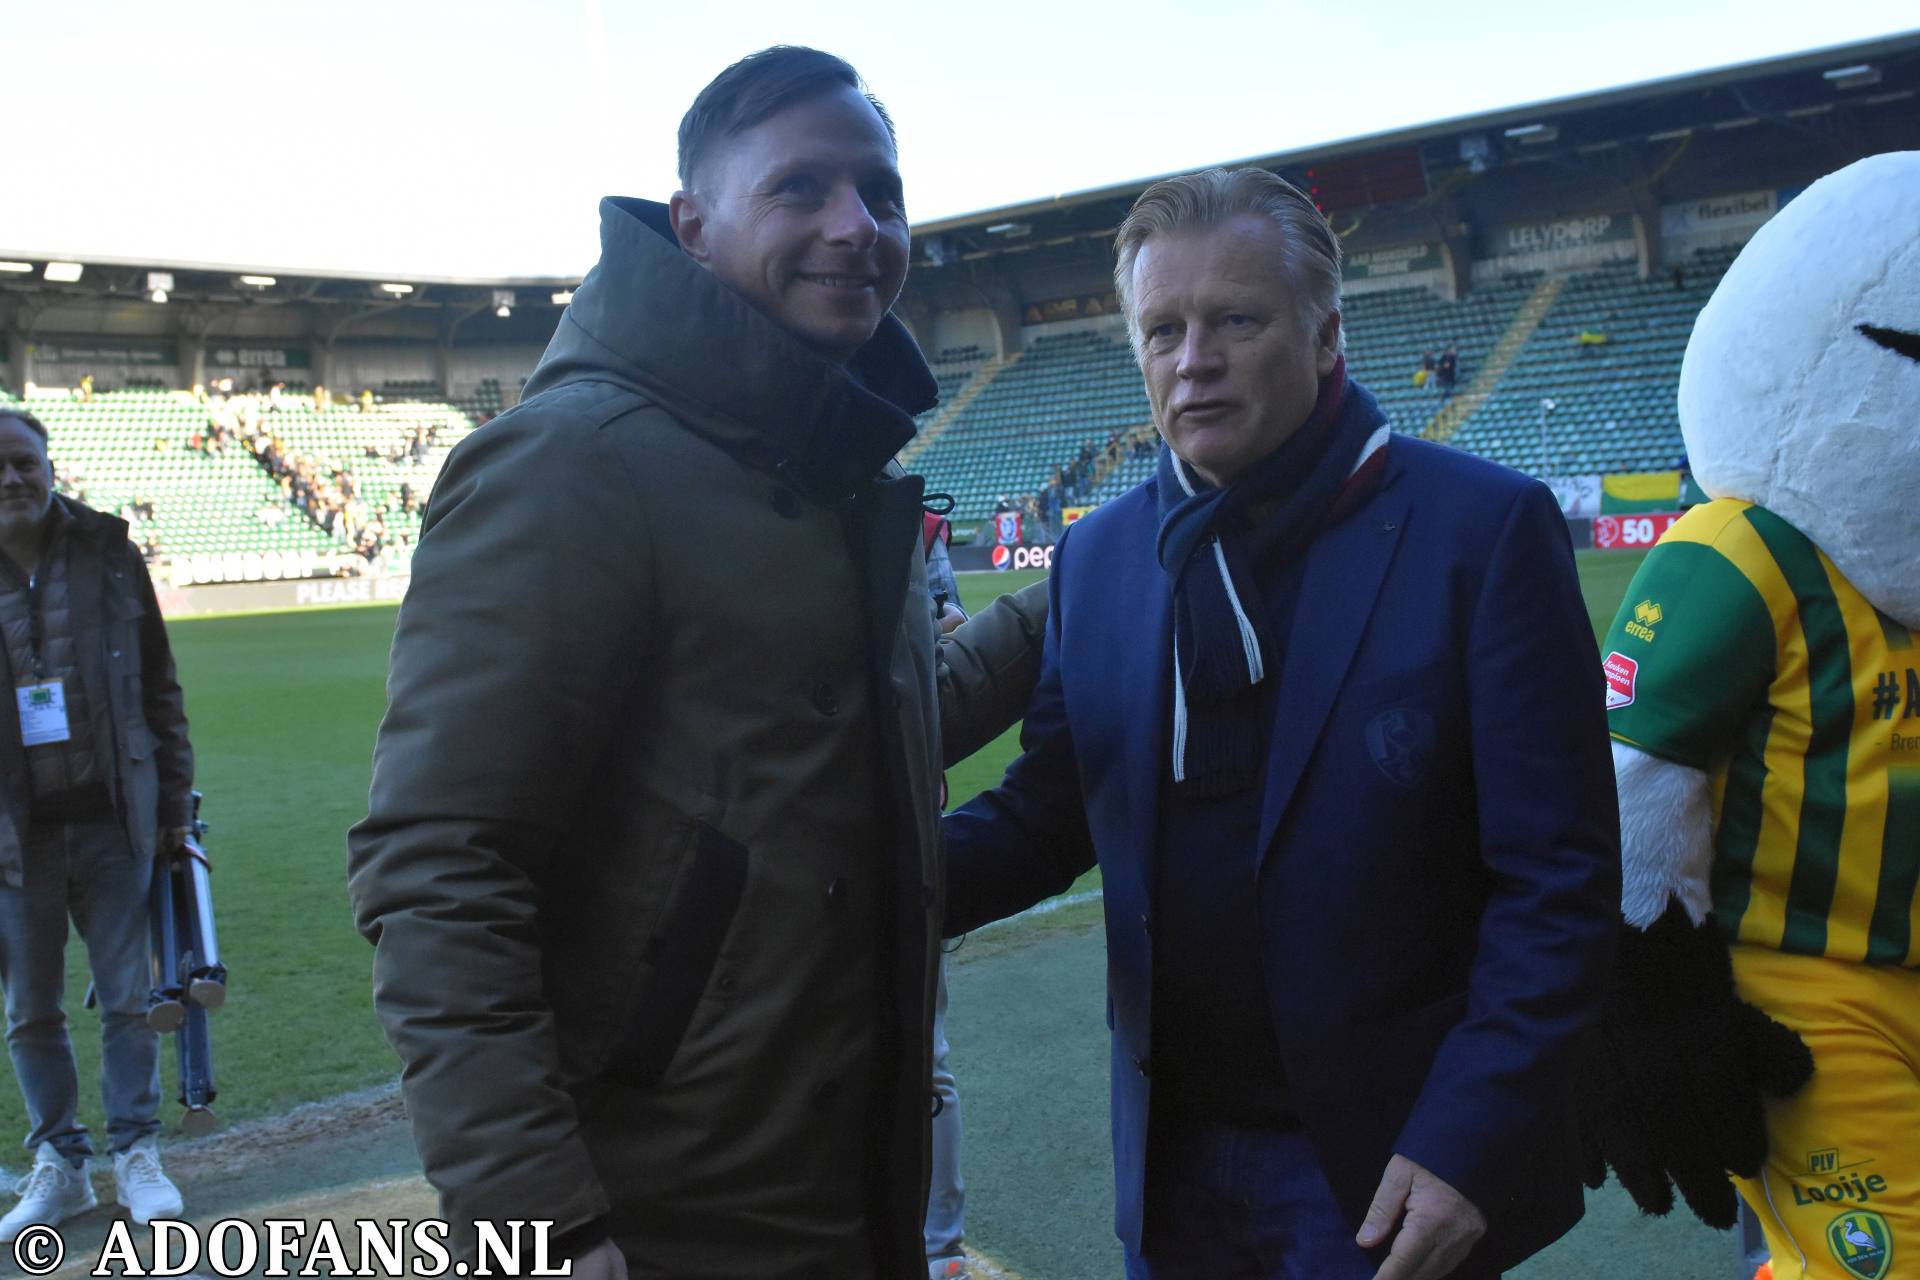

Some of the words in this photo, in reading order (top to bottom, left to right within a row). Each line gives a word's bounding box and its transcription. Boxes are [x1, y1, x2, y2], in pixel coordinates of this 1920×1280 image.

[238, 349, 286, 366] errea
[1622, 518, 1654, 544] 50
[297, 580, 369, 604] PLEASE
[1625, 620, 1655, 642] errea
[1604, 669, 1630, 686] mpioen
[1811, 1153, 1834, 1172] PLV
[1792, 1172, 1887, 1206] Looije
